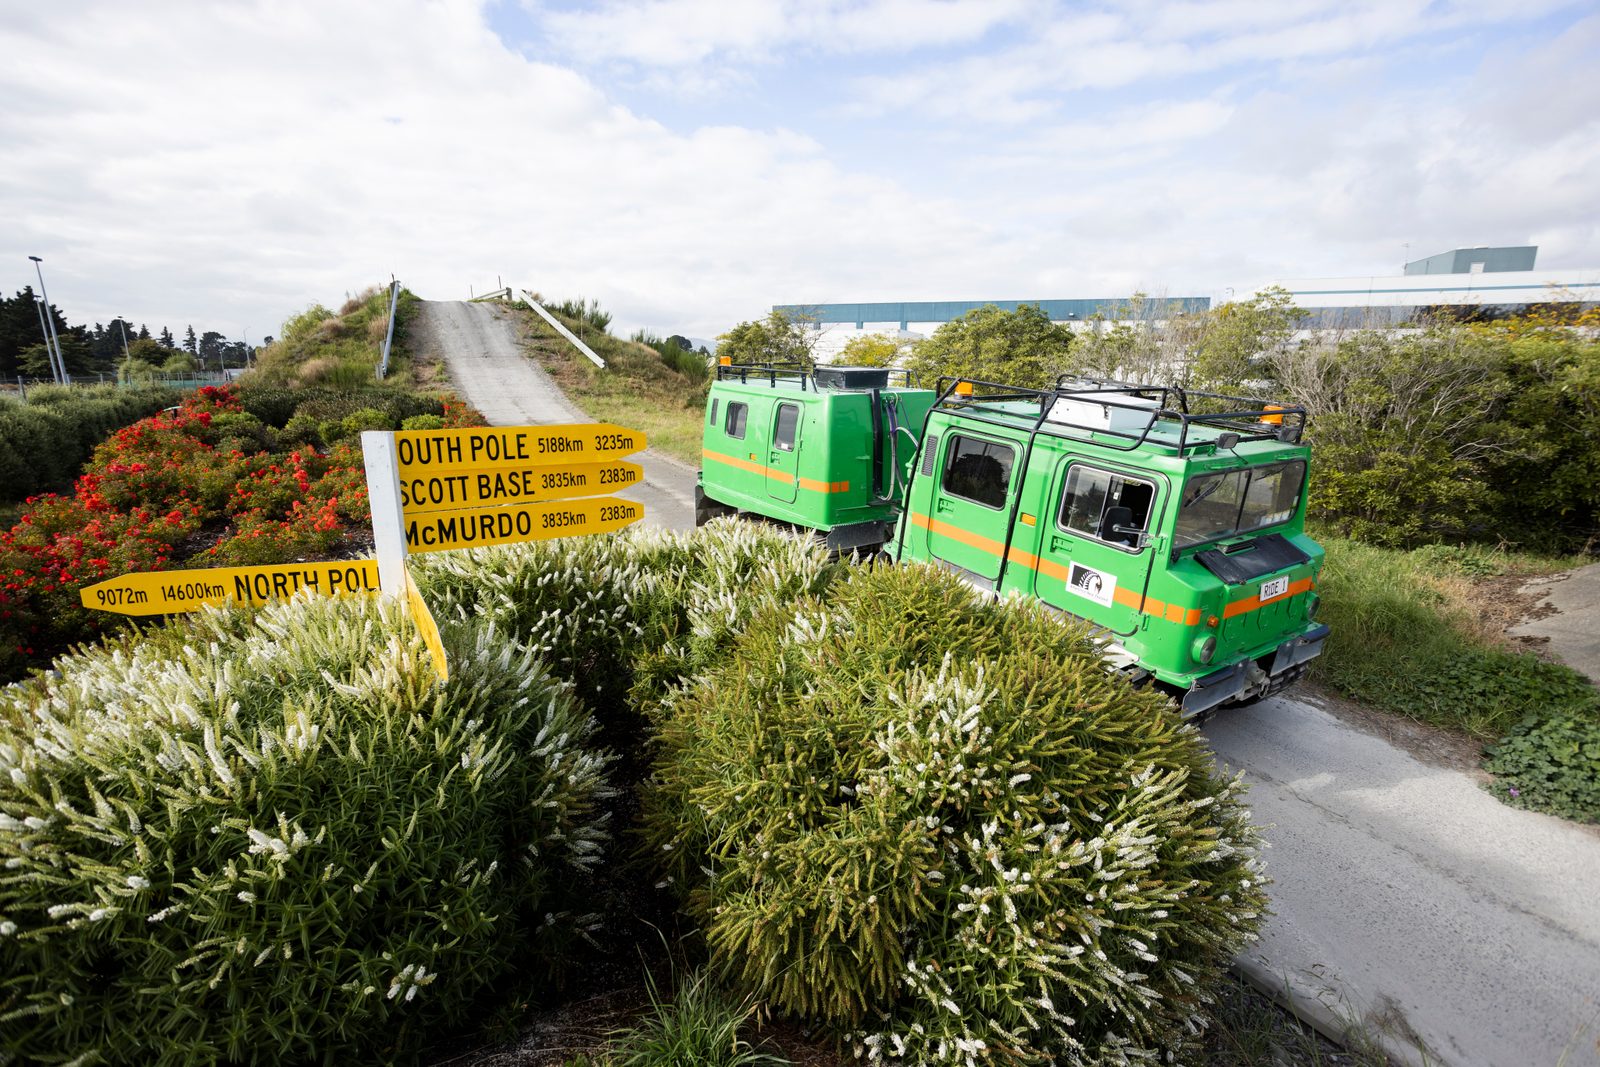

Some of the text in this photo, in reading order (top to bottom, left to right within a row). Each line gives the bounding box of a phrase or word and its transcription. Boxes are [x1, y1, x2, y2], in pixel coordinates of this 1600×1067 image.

[399, 434, 633, 465] OUTH POLE 5188km 3235m
[400, 468, 636, 507] SCOTT BASE 3835km 2383m
[405, 505, 636, 546] McMURDO 3835km 2383m
[97, 566, 382, 605] 9072m 14600km NORTH POL
[1263, 581, 1280, 598] RIDE
